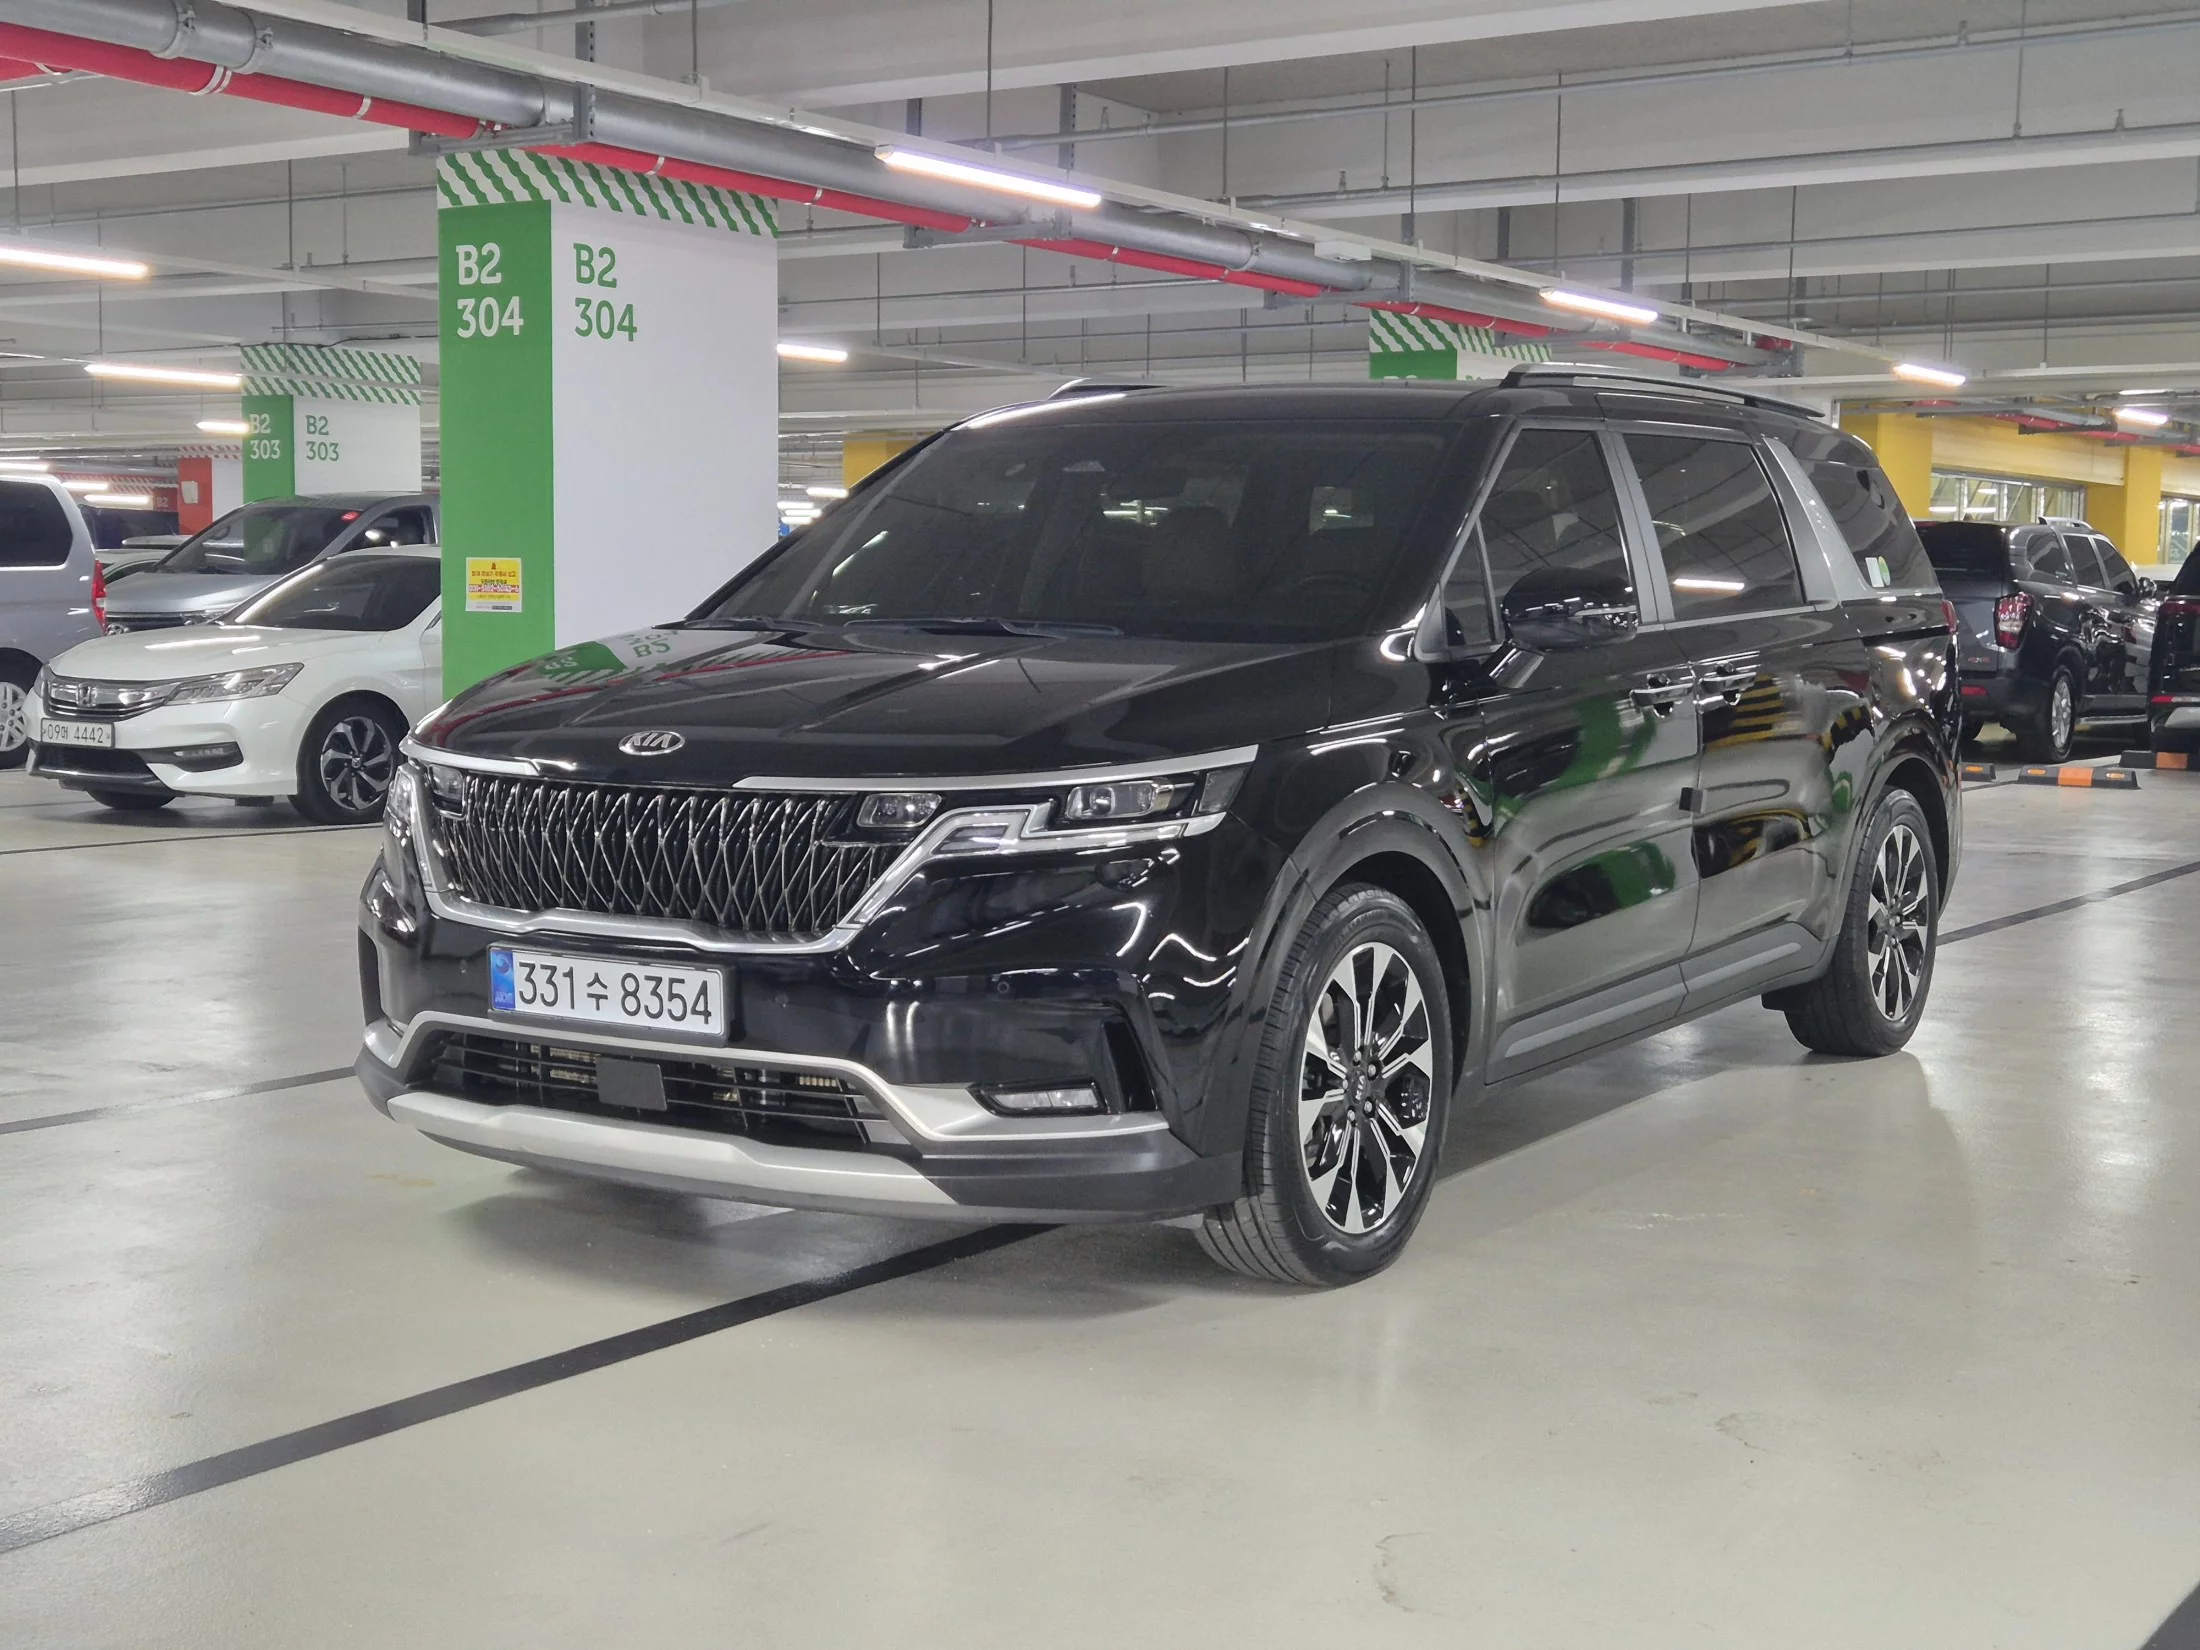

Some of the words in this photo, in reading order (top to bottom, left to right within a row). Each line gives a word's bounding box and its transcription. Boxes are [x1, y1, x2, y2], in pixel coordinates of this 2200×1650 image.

[456, 242, 502, 285] B2
[573, 242, 618, 288] B2
[456, 296, 524, 338] 304
[574, 297, 638, 342] 304
[249, 413, 271, 434] B2
[305, 415, 330, 436] B2
[250, 439, 281, 460] 303
[306, 441, 340, 461] 303
[73, 725, 104, 743] 4442
[624, 731, 674, 750] KIA
